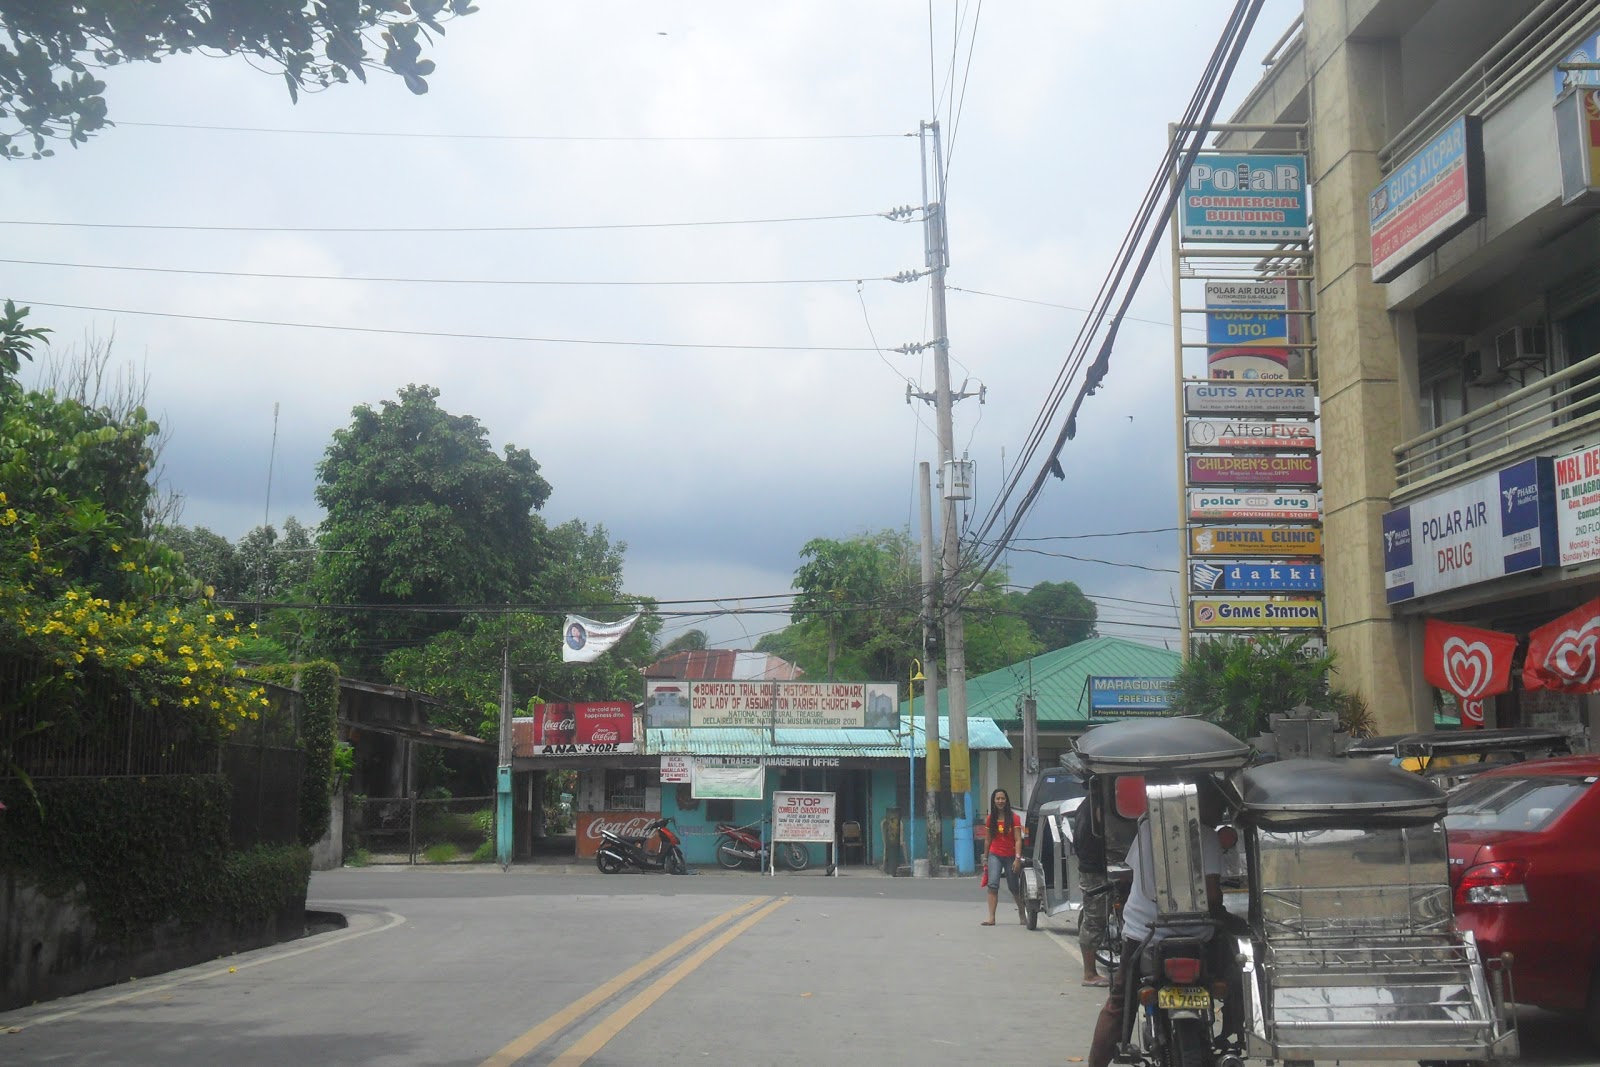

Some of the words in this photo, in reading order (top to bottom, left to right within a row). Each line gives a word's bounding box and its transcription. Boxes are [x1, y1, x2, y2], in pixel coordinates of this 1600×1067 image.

[1390, 164, 1417, 203] GUTS
[1420, 126, 1462, 180] ATCPAR
[1189, 196, 1299, 208] COMMERCIAL
[1207, 210, 1285, 222] BUILDING
[1207, 286, 1236, 295] POLAR
[1254, 287, 1279, 295] DRUG
[1228, 324, 1267, 336] DITO!
[1260, 372, 1284, 380] Globe
[1196, 387, 1237, 397] GUTS
[1245, 388, 1305, 397] ATCPAR
[1222, 424, 1310, 437] AfterFive
[1196, 459, 1269, 470] CHILDREN'S
[1271, 459, 1312, 470] CLINIC
[1556, 456, 1582, 487] MBL
[1561, 487, 1571, 500] DR.
[1200, 497, 1241, 507] polar
[1274, 497, 1309, 508] drug
[1569, 499, 1582, 510] Gen.
[1422, 509, 1463, 544] POLAR
[1465, 501, 1488, 530] AIR
[1576, 524, 1587, 536] 2ND
[1216, 531, 1265, 542] DENTAL
[1271, 531, 1316, 543] CLINIC
[1569, 539, 1590, 550] Monday
[1437, 541, 1473, 573] DRUG
[1562, 551, 1582, 562] Sunday
[1583, 549, 1590, 559] by
[1231, 568, 1316, 579] dakki
[1218, 604, 1261, 618] GAME
[1264, 604, 1319, 618] STATION
[701, 684, 735, 695] BONIFACIO
[739, 684, 757, 696] TRIAL
[760, 684, 781, 696] HOUE
[784, 685, 822, 697] HISTORICAL
[826, 685, 863, 697] LANDMARK
[693, 698, 706, 709] OUR
[710, 698, 729, 709] LADY
[732, 698, 741, 709] OF
[793, 699, 818, 710] PARISH
[822, 700, 849, 711] CHURCH
[1118, 695, 1140, 703] FREE
[1143, 695, 1161, 703] USE
[586, 744, 620, 753] STORE
[760, 757, 810, 766] MANAGEMENT
[813, 758, 840, 766] OFFICE
[787, 798, 821, 806] STOP
